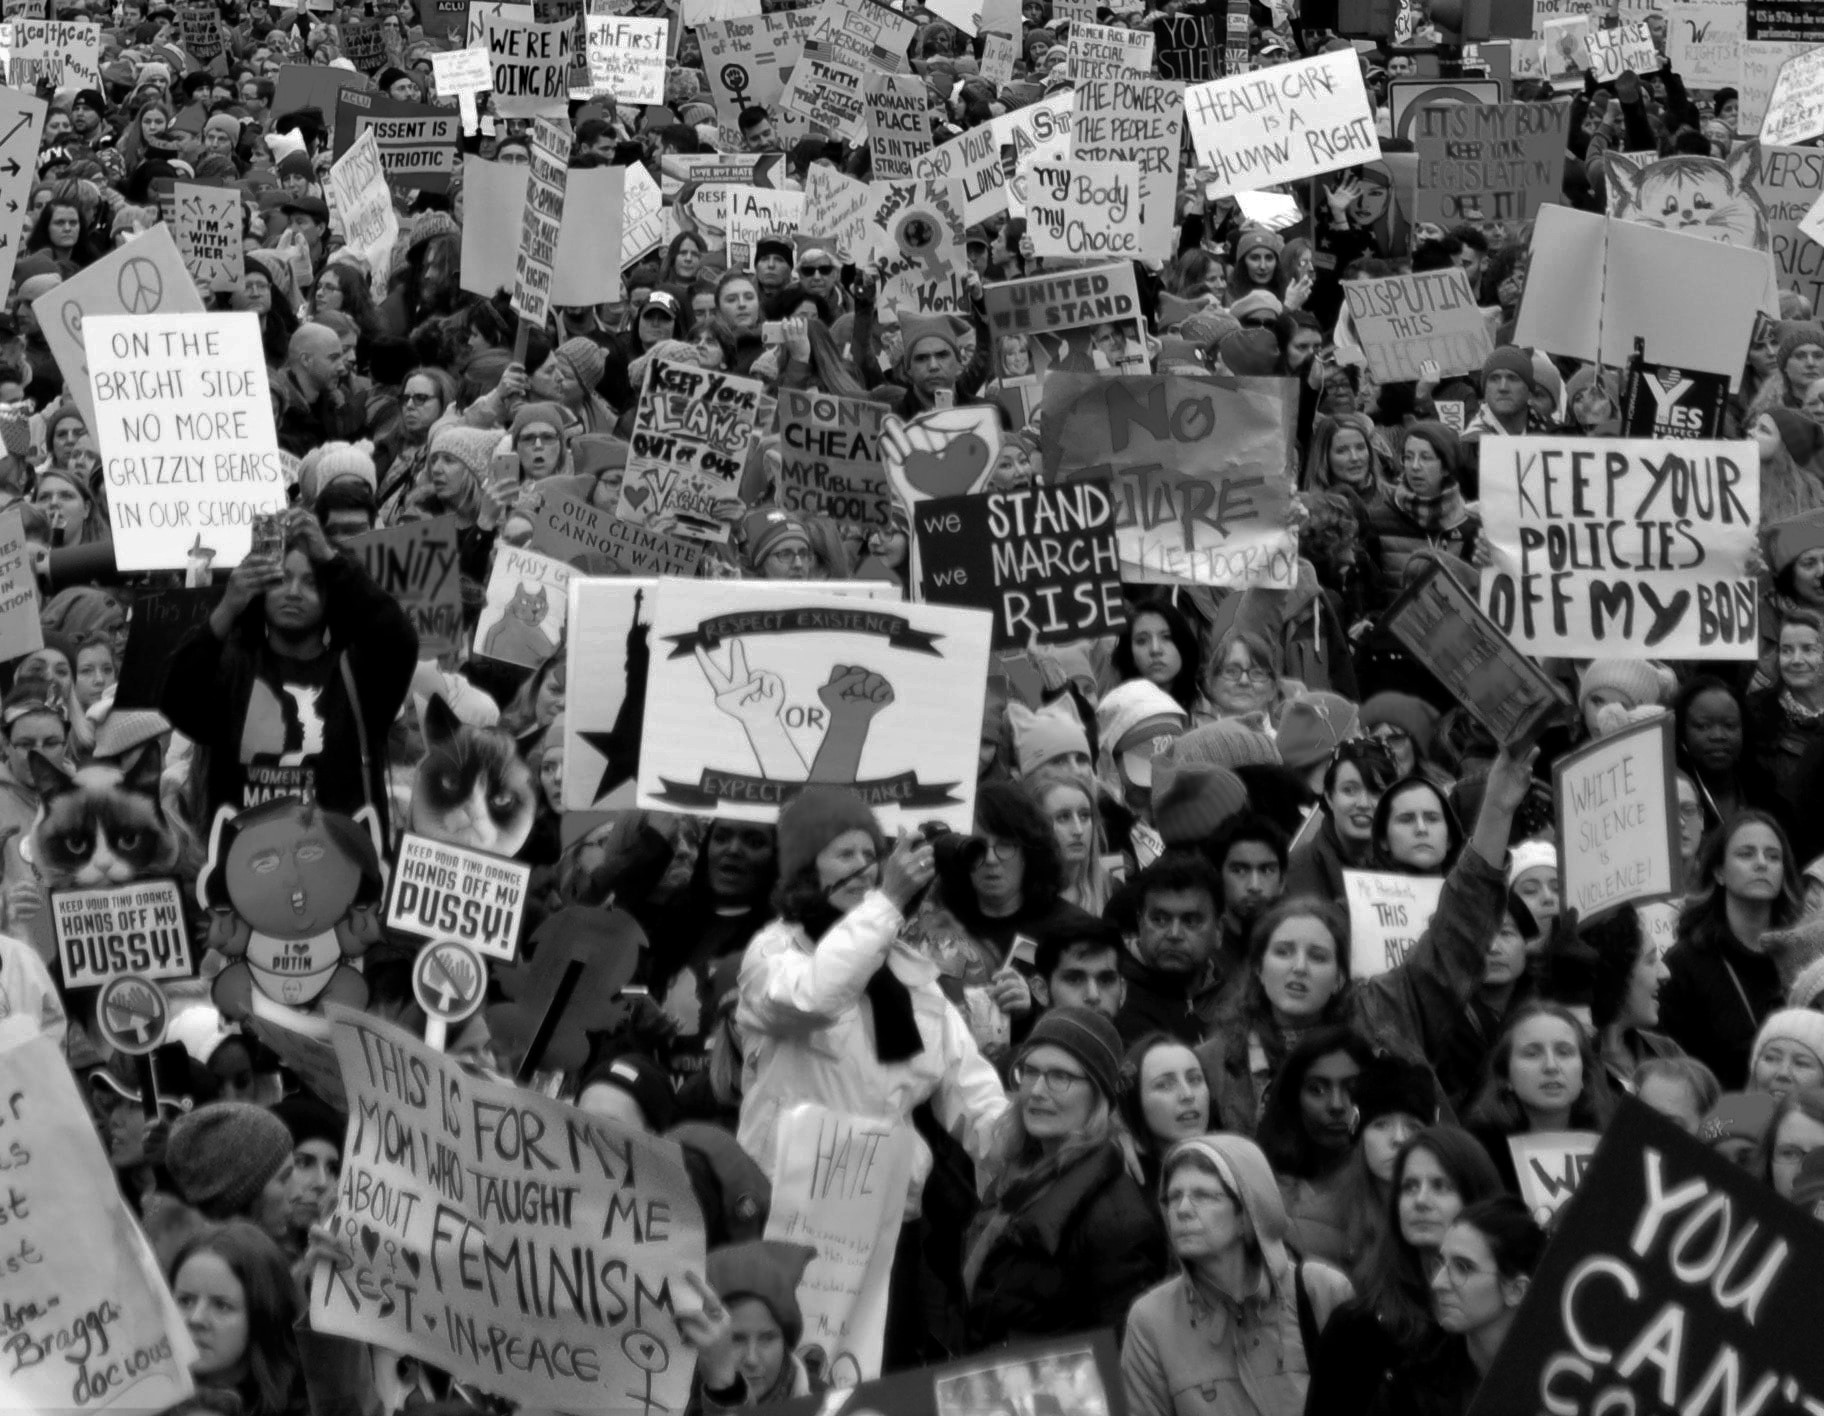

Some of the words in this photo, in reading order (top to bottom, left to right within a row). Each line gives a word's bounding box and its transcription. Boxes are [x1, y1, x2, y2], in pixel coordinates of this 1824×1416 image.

[438, 0, 465, 12] ACLU
[1209, 136, 1289, 186] HUMAN
[1304, 115, 1373, 167] RIGHT
[190, 232, 228, 247] WITH
[197, 220, 219, 232] I'M
[194, 246, 222, 259] HER
[112, 333, 148, 357] ON
[161, 331, 220, 356] THE
[94, 372, 184, 401] BRIGHT
[201, 371, 257, 398] SIDE
[122, 413, 160, 442] NO
[175, 410, 249, 440] MORE
[109, 454, 204, 486] GRIZZLY
[215, 453, 278, 484] BEARS
[1515, 451, 1629, 520] KEEP
[1636, 453, 1751, 526] YOUR
[116, 504, 141, 528] IN
[150, 503, 190, 527] OUR
[989, 487, 1111, 538] STAND
[992, 538, 1117, 586] MARCH
[1520, 519, 1707, 571] POLICIES
[2, 580, 14, 594] IN
[1002, 583, 1128, 637] RISE
[1489, 572, 1576, 639] OFF
[1591, 580, 1690, 647] MY
[787, 704, 824, 731] OR
[396, 886, 514, 949] PUSSY!
[357, 1027, 429, 1110] THIS
[439, 1068, 461, 1139] IS
[473, 1098, 563, 1171] FOR
[568, 1117, 637, 1188] MY
[353, 1098, 417, 1167] MOM
[422, 1132, 464, 1202] WHO
[466, 1168, 580, 1227] TAUGHT
[602, 1191, 670, 1244] ME
[344, 1170, 421, 1238] ABOUT
[431, 1204, 677, 1328] FEMINISM
[1633, 1146, 1788, 1325] YOU
